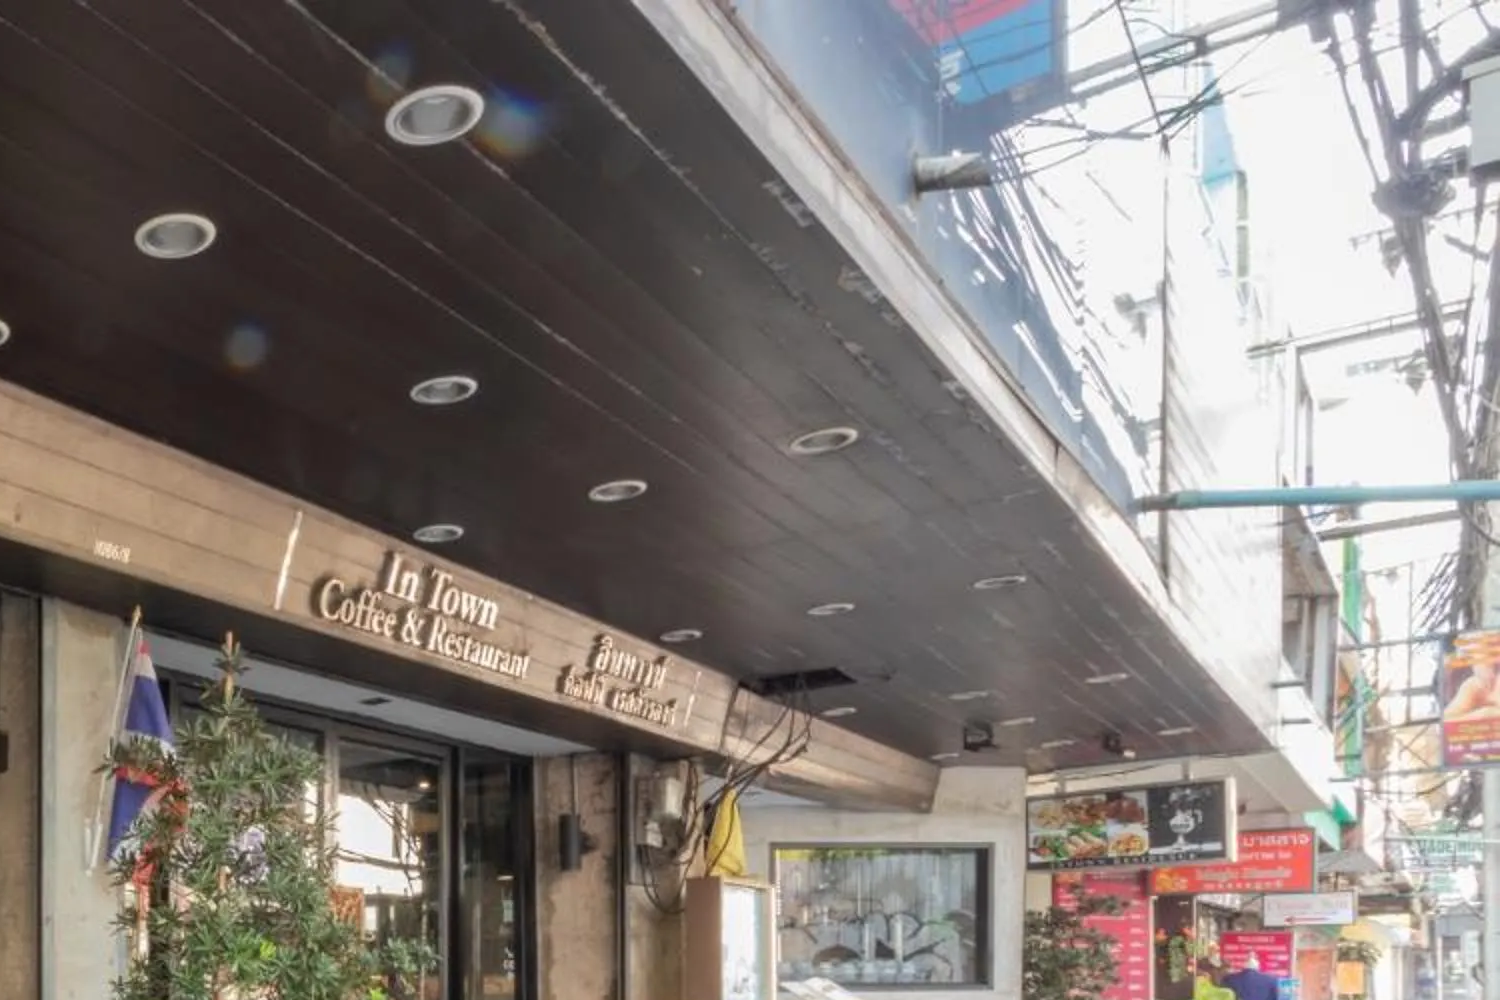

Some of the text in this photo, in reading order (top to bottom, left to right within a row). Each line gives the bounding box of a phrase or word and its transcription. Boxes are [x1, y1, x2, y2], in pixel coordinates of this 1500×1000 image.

[320, 579, 531, 679] Coffee & Restaurant
[385, 552, 500, 630] In Town
